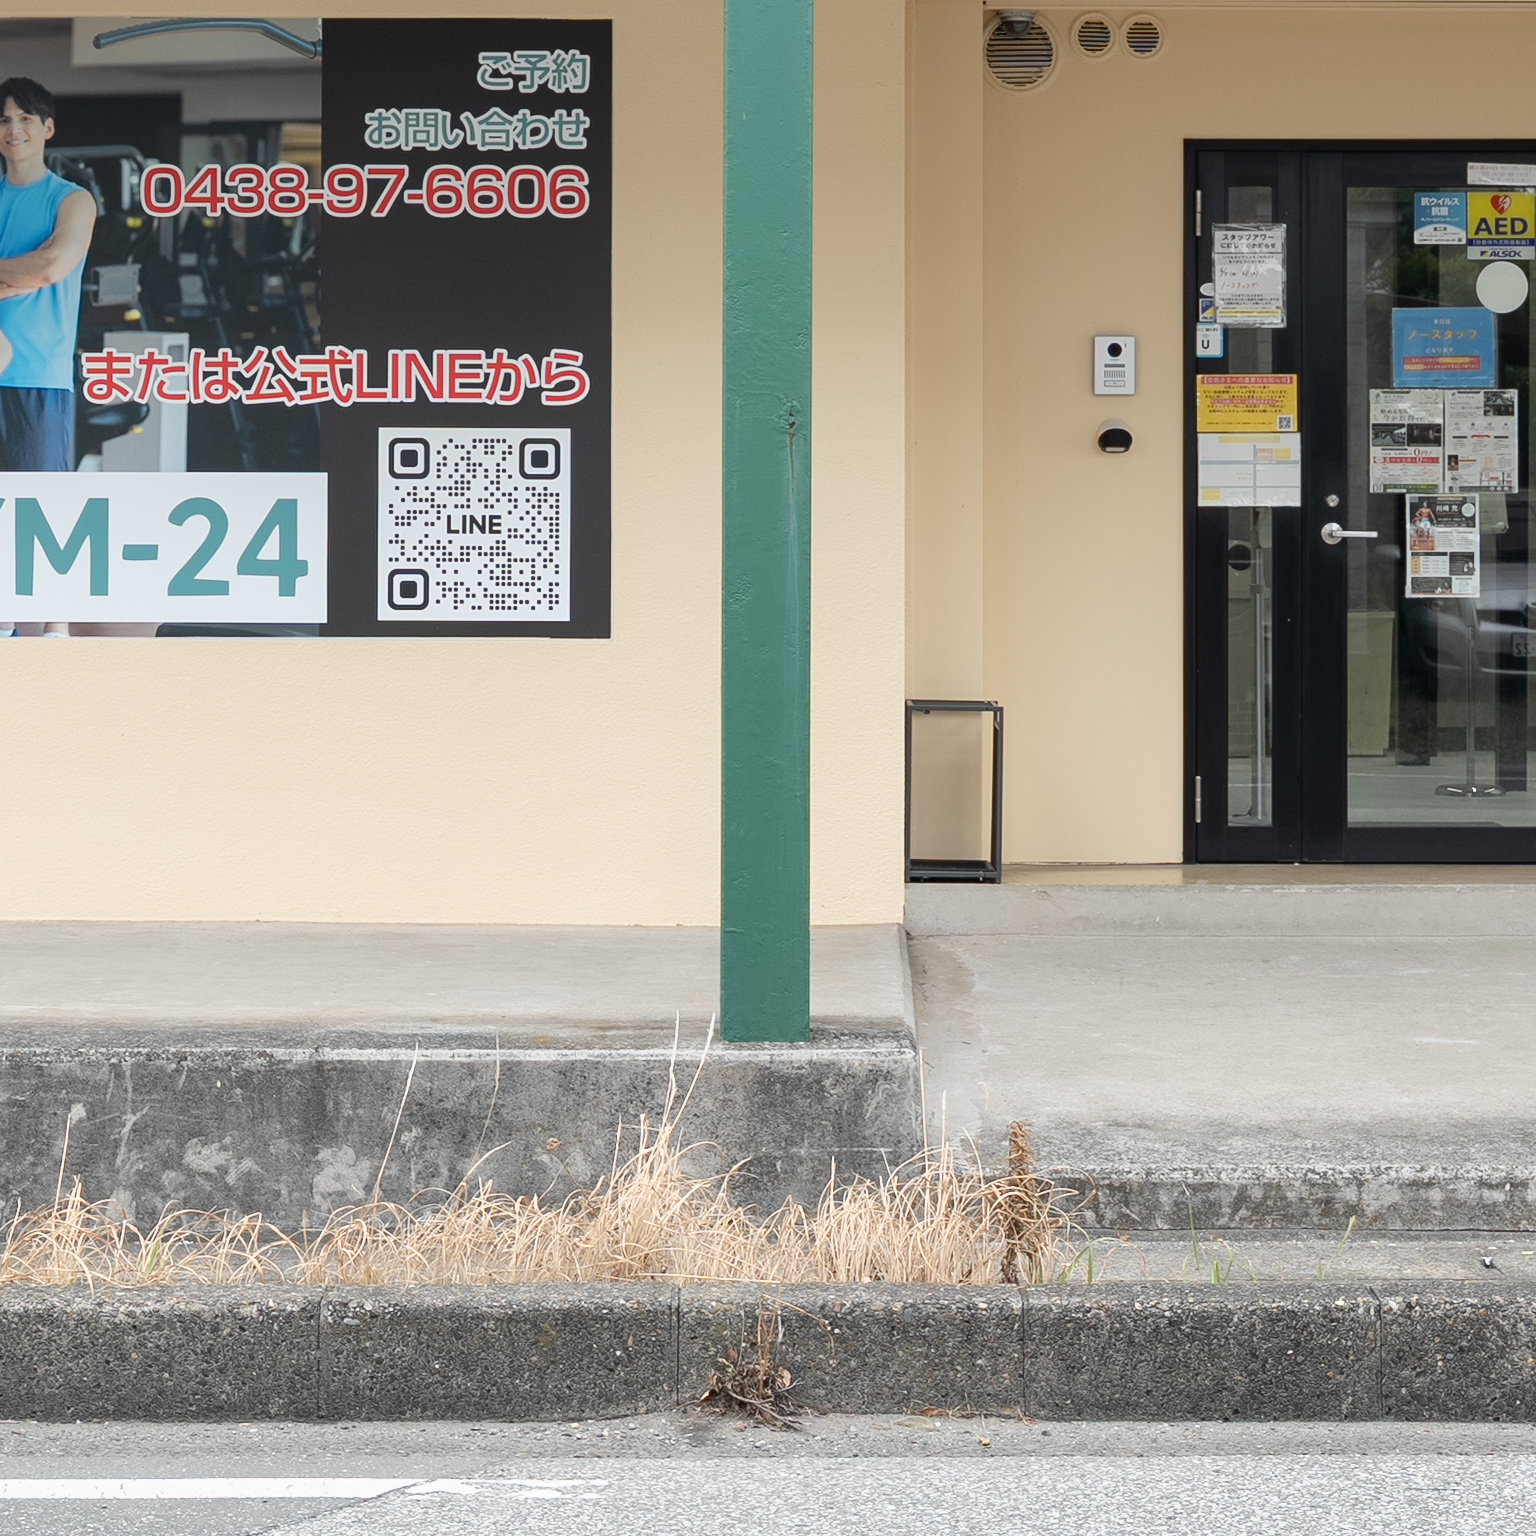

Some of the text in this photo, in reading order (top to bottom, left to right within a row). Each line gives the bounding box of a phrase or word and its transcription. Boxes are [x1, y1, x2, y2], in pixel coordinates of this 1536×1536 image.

[477, 51, 589, 92] ご予約
[365, 109, 589, 150] お問い合わせ
[142, 165, 589, 217] 0438-97-6606
[1421, 197, 1460, 206] 抗ウイルス
[1474, 217, 1529, 236] AED
[1222, 233, 1275, 241] スタッフアワー
[1489, 250, 1522, 258] ALSOK
[1408, 329, 1478, 341] ノースタッフ
[81, 347, 589, 404] または公式LINEから
[446, 514, 502, 535] LINE
